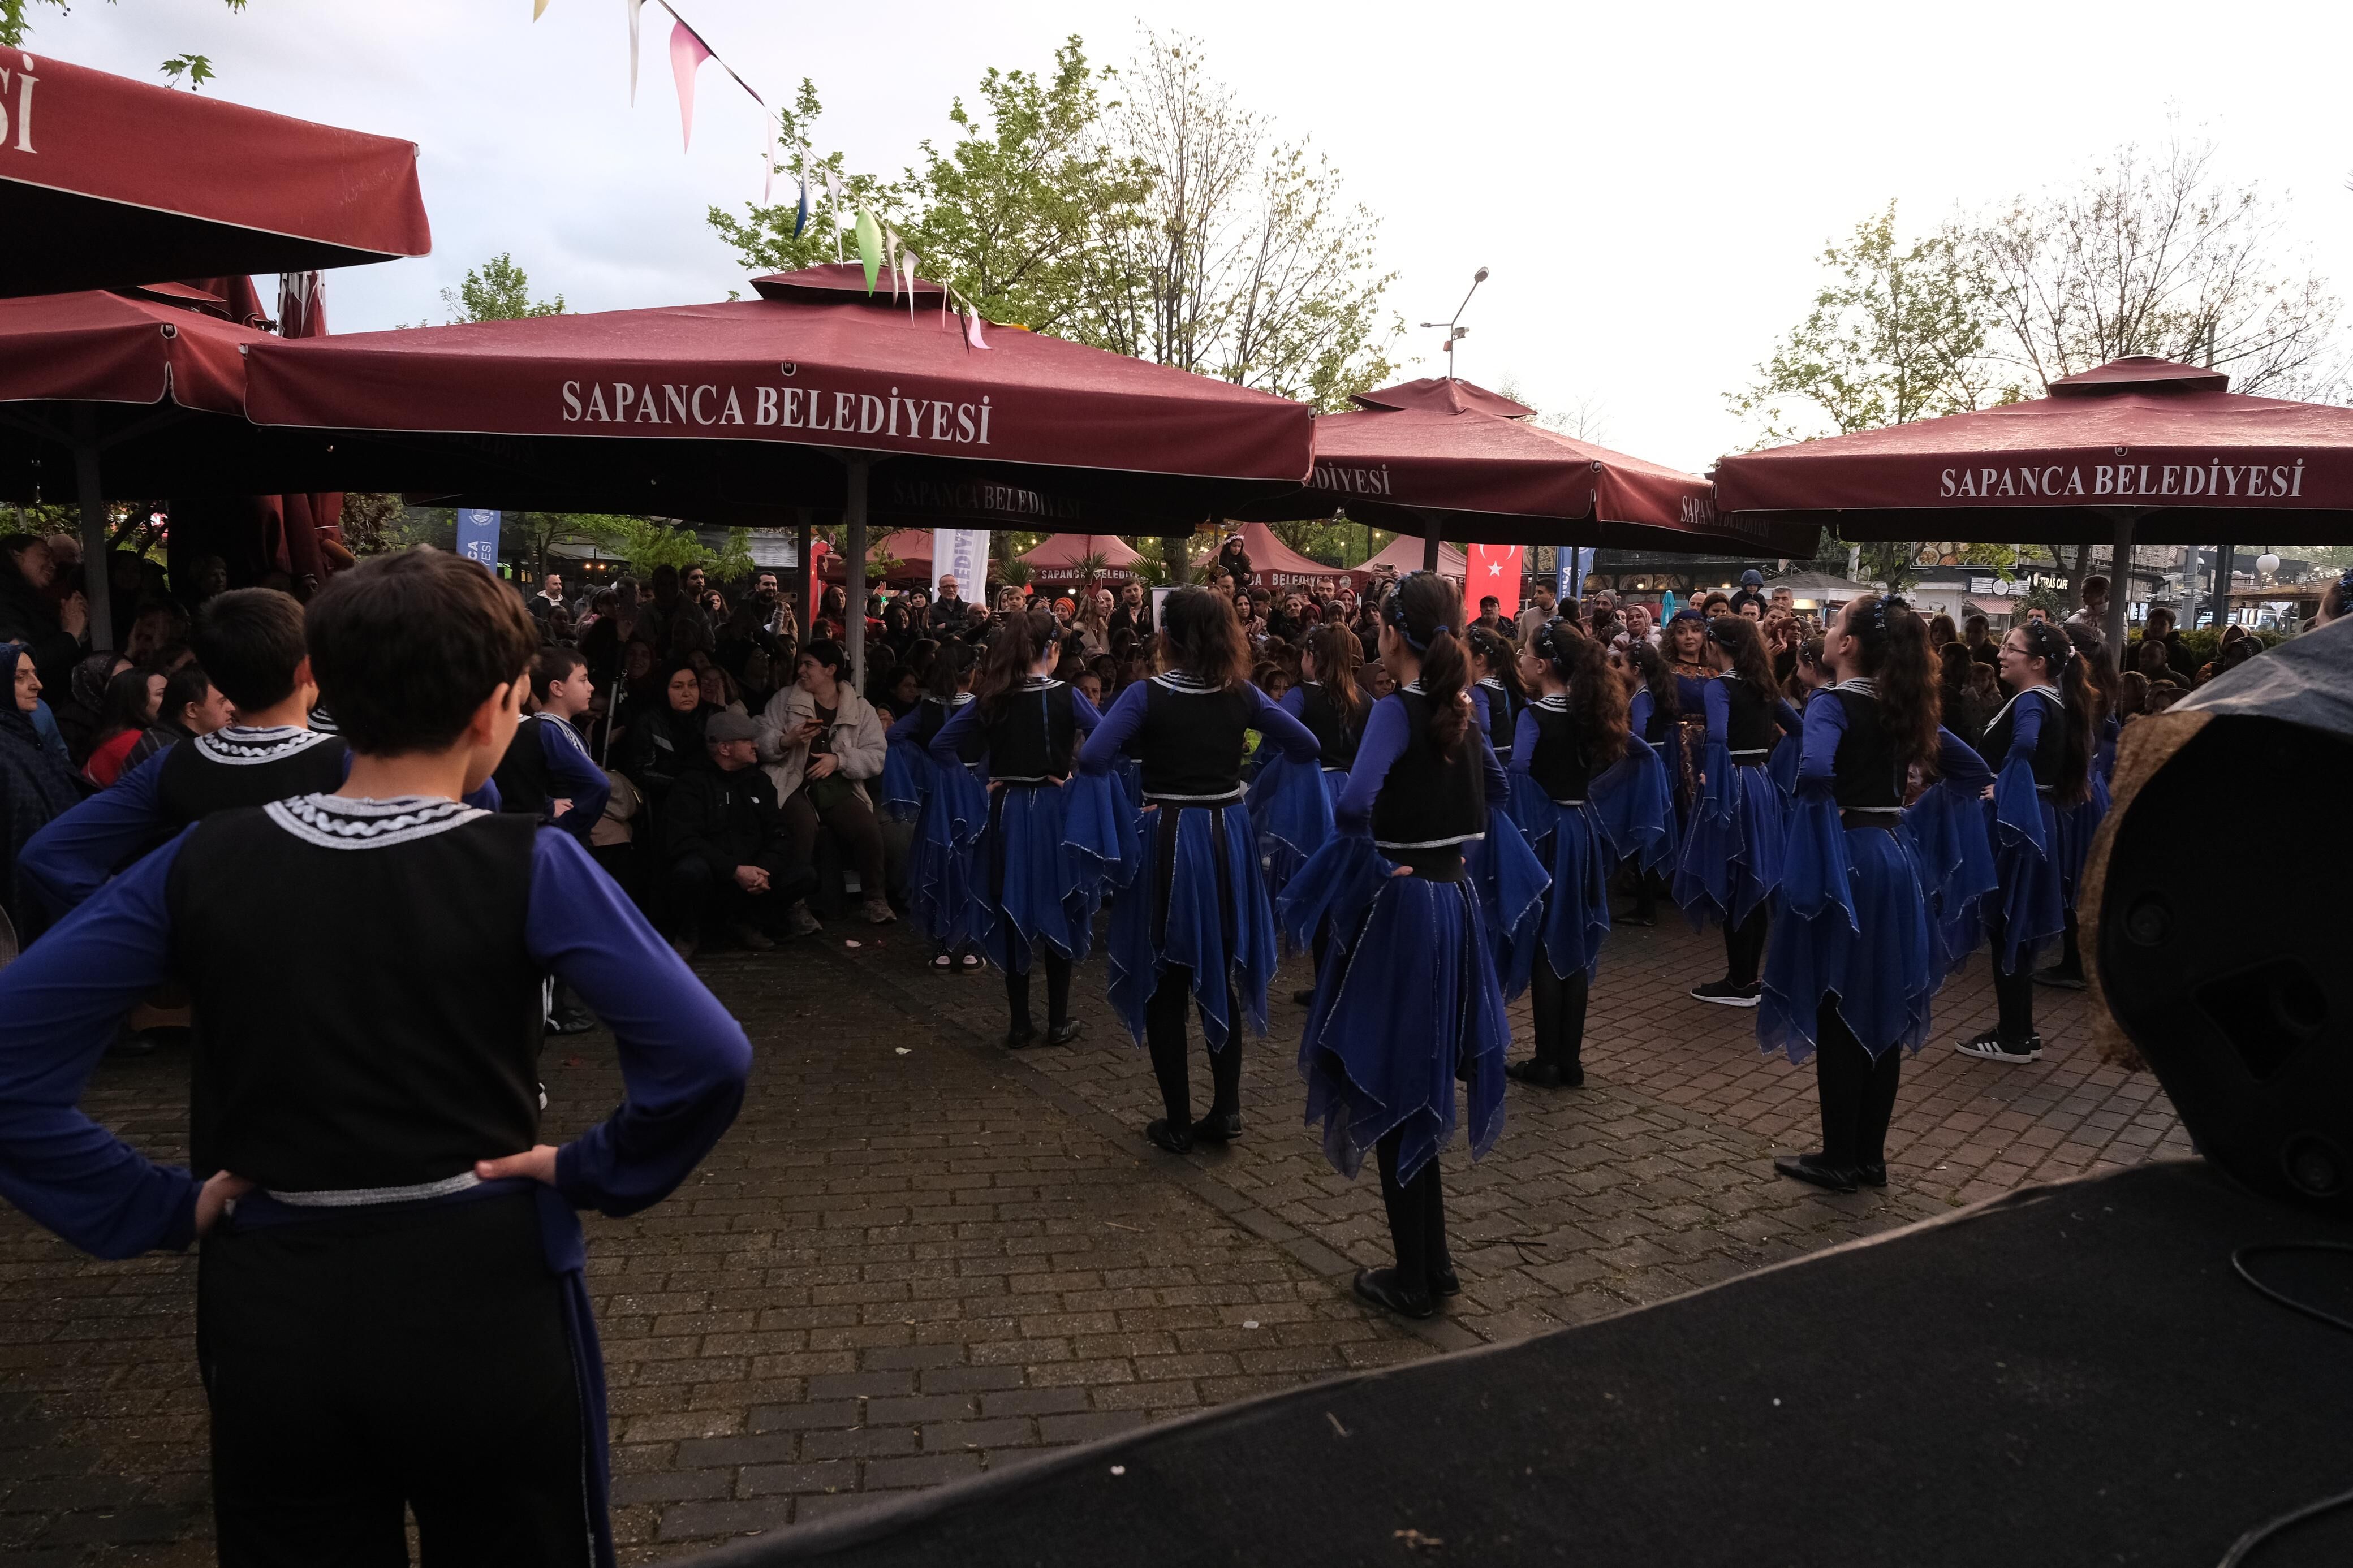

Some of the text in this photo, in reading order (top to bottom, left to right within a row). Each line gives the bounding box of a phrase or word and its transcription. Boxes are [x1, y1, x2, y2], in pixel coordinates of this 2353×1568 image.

[562, 381, 993, 445] SAPANCA BELEDİYESİ
[1940, 457, 2305, 498] SAPANCA BELEDİYESİ
[2056, 578, 2068, 590] CAFE
